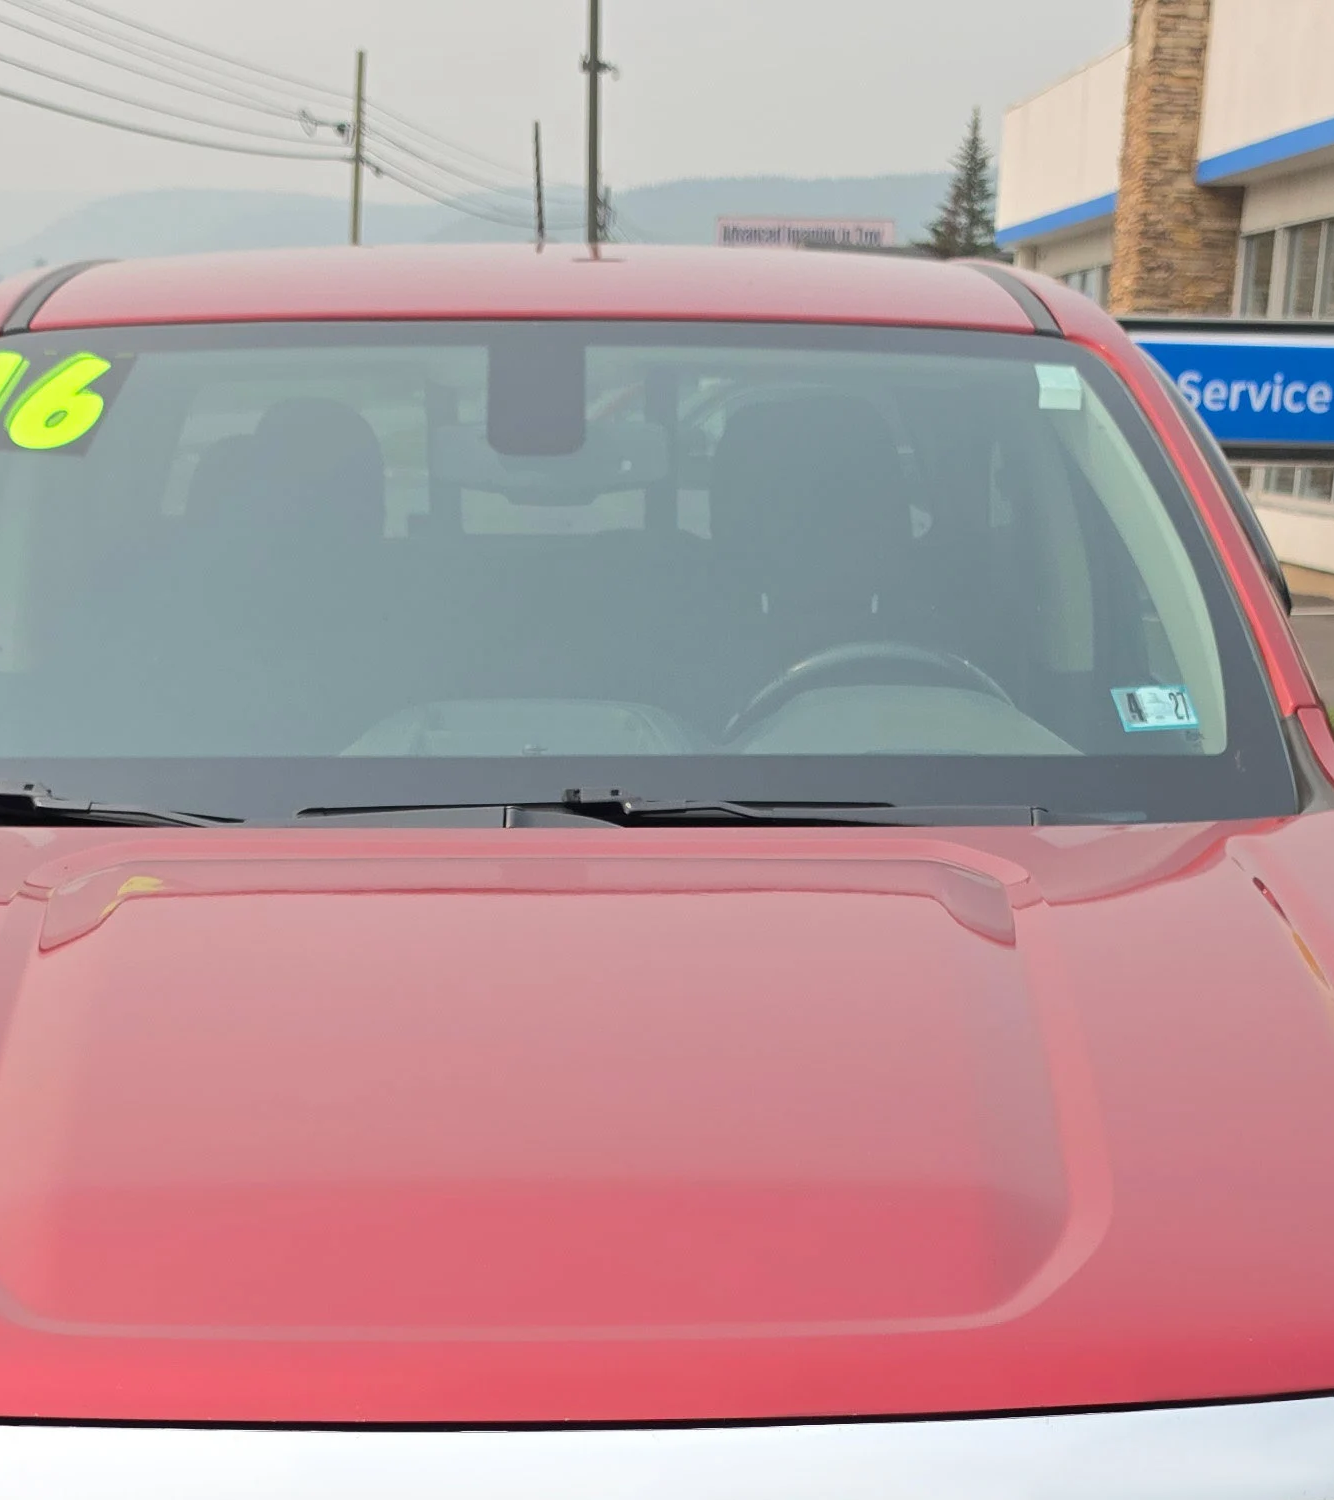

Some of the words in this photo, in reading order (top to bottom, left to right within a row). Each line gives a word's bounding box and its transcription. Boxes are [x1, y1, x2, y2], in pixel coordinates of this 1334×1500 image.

[1176, 369, 1334, 414] Service
[1125, 691, 1148, 723] 4
[1168, 691, 1191, 721] 27
